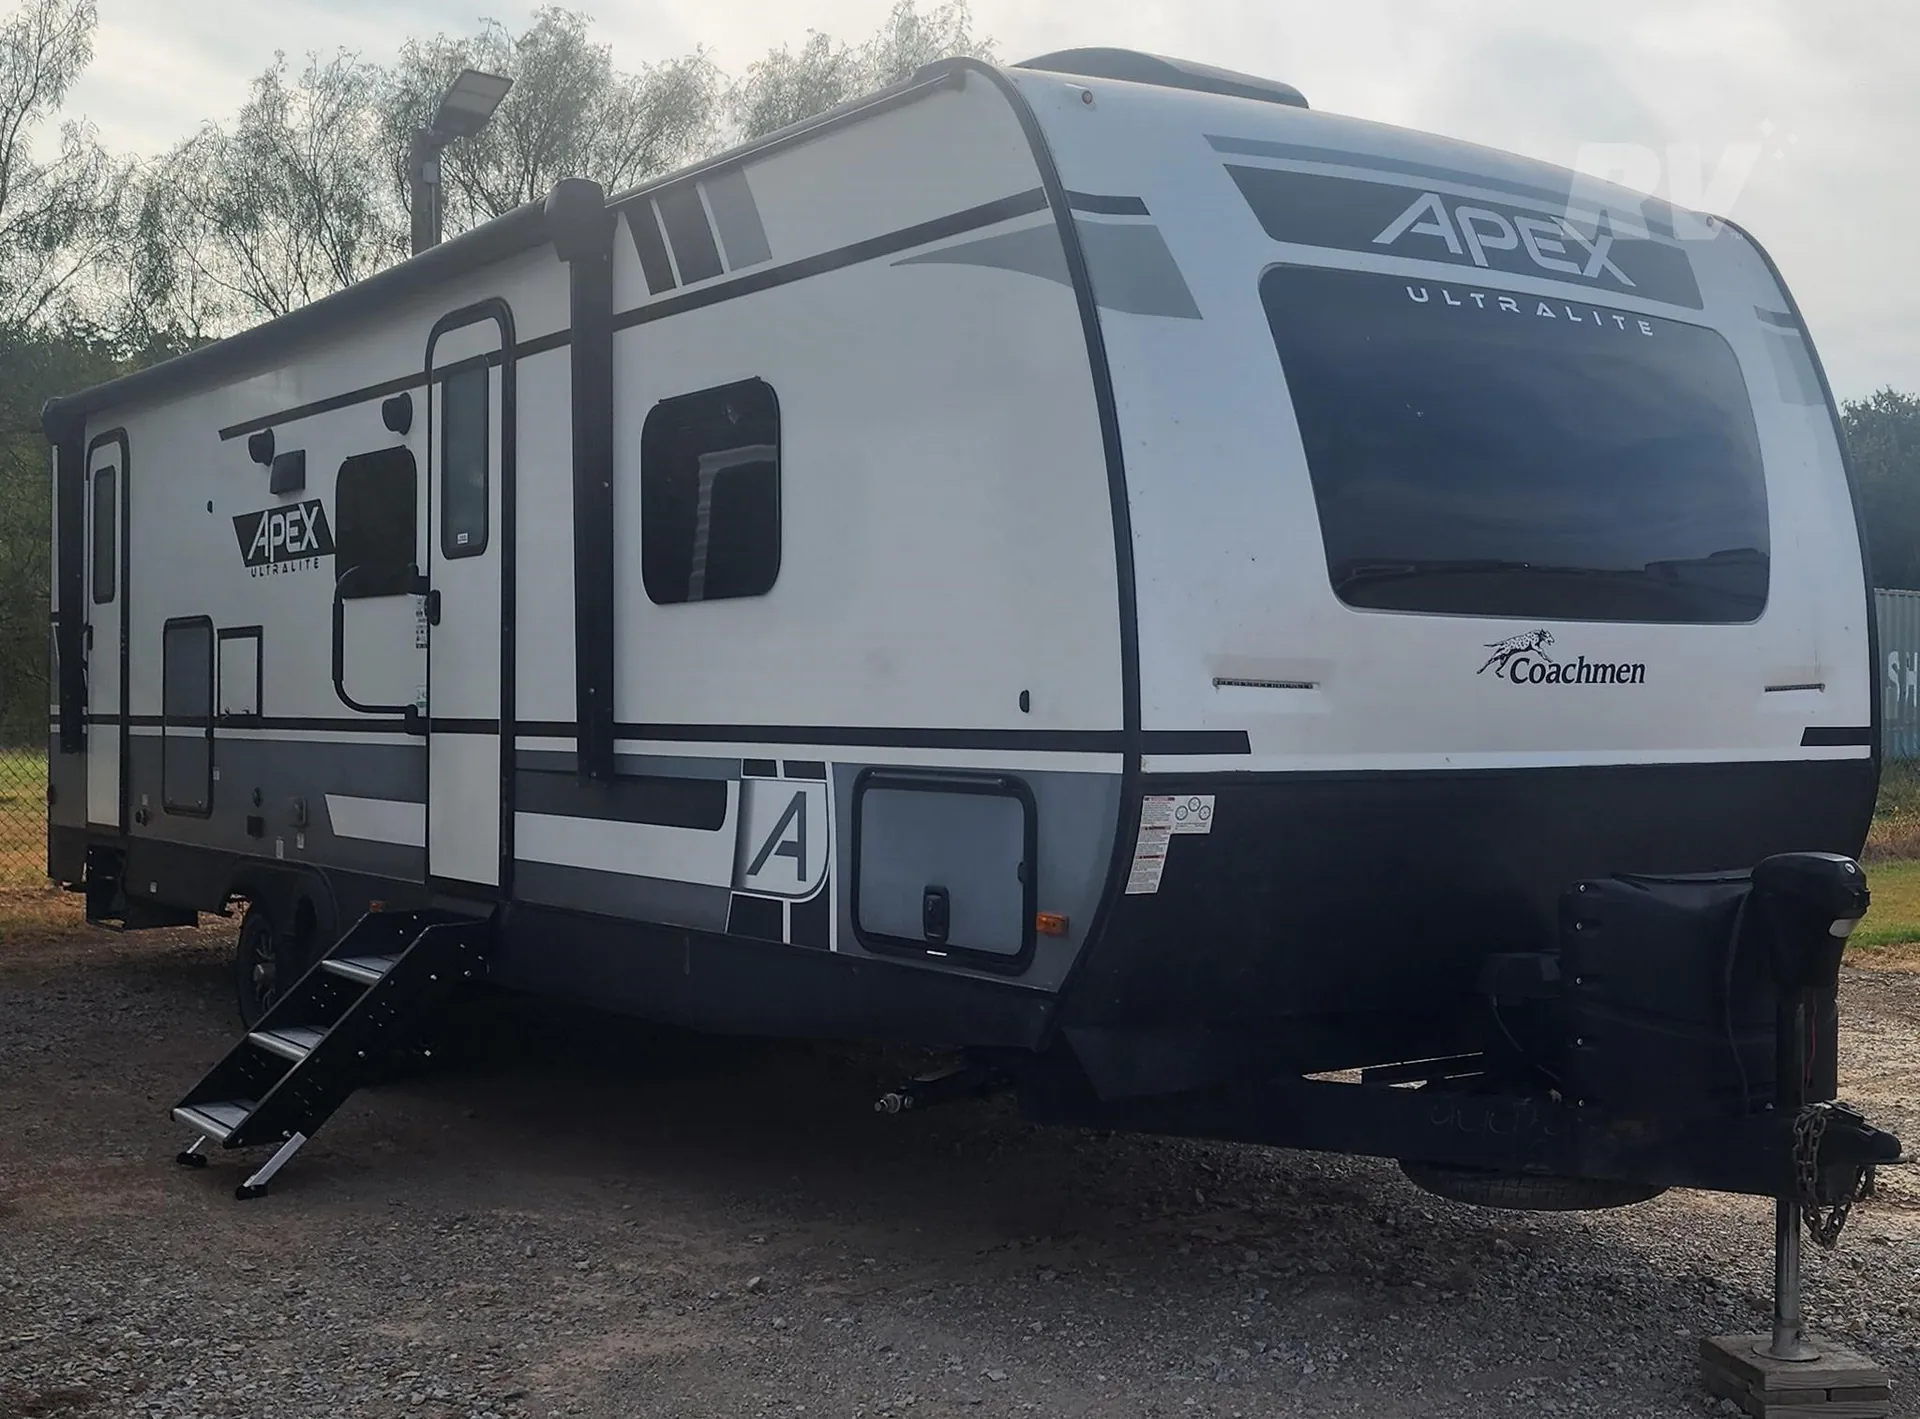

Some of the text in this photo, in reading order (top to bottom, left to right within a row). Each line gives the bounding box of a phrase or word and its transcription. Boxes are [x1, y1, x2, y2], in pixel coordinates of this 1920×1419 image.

[1371, 191, 1637, 287] APEX
[1405, 285, 1654, 336] ULTRALITE
[247, 503, 319, 563] APEX
[251, 557, 319, 578] ULTRALITE
[1509, 655, 1646, 684] Coachmen
[746, 790, 807, 882] A
